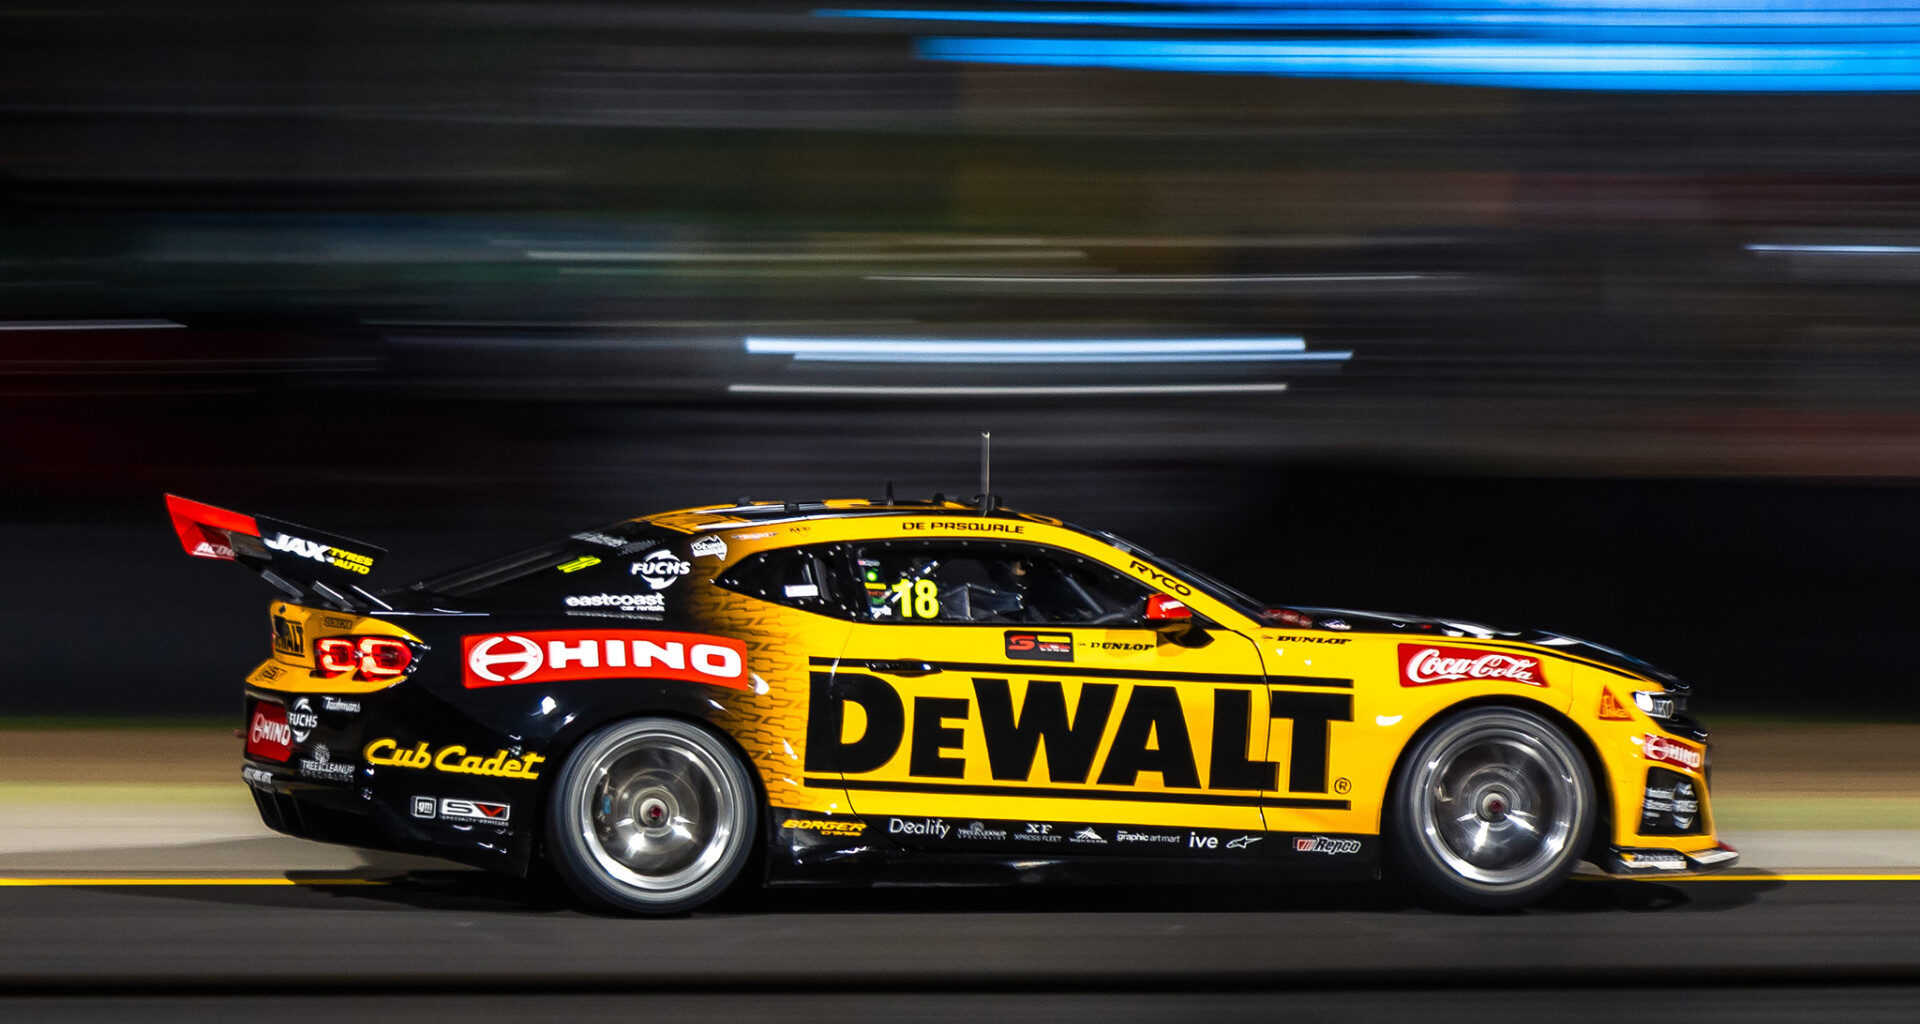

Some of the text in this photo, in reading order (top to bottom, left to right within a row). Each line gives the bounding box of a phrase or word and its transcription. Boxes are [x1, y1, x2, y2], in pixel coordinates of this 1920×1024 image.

[902, 522, 1024, 534] DE PASQUALE
[263, 532, 331, 563] JAX
[328, 546, 374, 567] TYRES
[333, 559, 370, 575] AUTO
[631, 561, 691, 575] FUCHS
[1129, 560, 1191, 597] RYCO
[565, 591, 664, 607] eastcoast
[891, 578, 940, 619] 18
[323, 616, 353, 630] SEIKO
[1090, 642, 1154, 651] DUNLOP
[1276, 636, 1351, 645] DUNLOP
[548, 640, 742, 678] HINO
[288, 714, 319, 728] FUCHS
[262, 721, 291, 746] HINO
[364, 737, 546, 780] Cub Cadet
[782, 819, 867, 831] BORGER
[890, 818, 950, 839] Dealify
[1042, 835, 1062, 843] FLEET
[1189, 832, 1218, 849] ive
[1313, 837, 1361, 854] Repco
